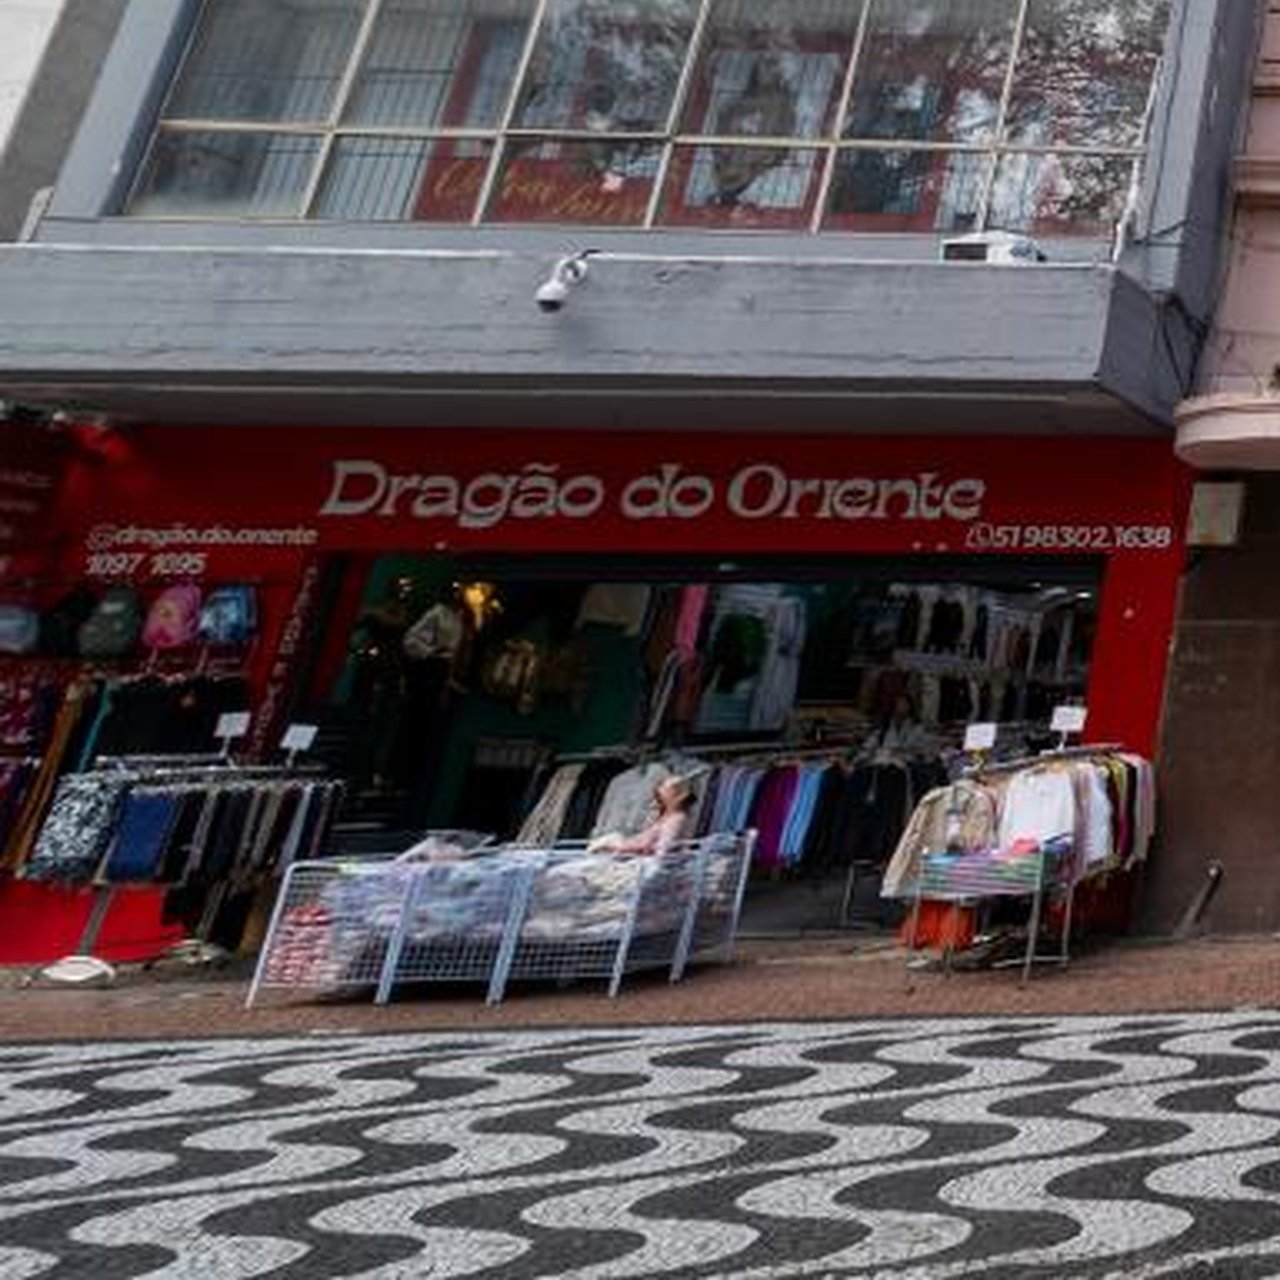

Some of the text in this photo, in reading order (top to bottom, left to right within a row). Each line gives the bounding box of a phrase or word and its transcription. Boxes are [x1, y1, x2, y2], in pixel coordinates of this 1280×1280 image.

[321, 460, 986, 528] Dragão do Oriente
